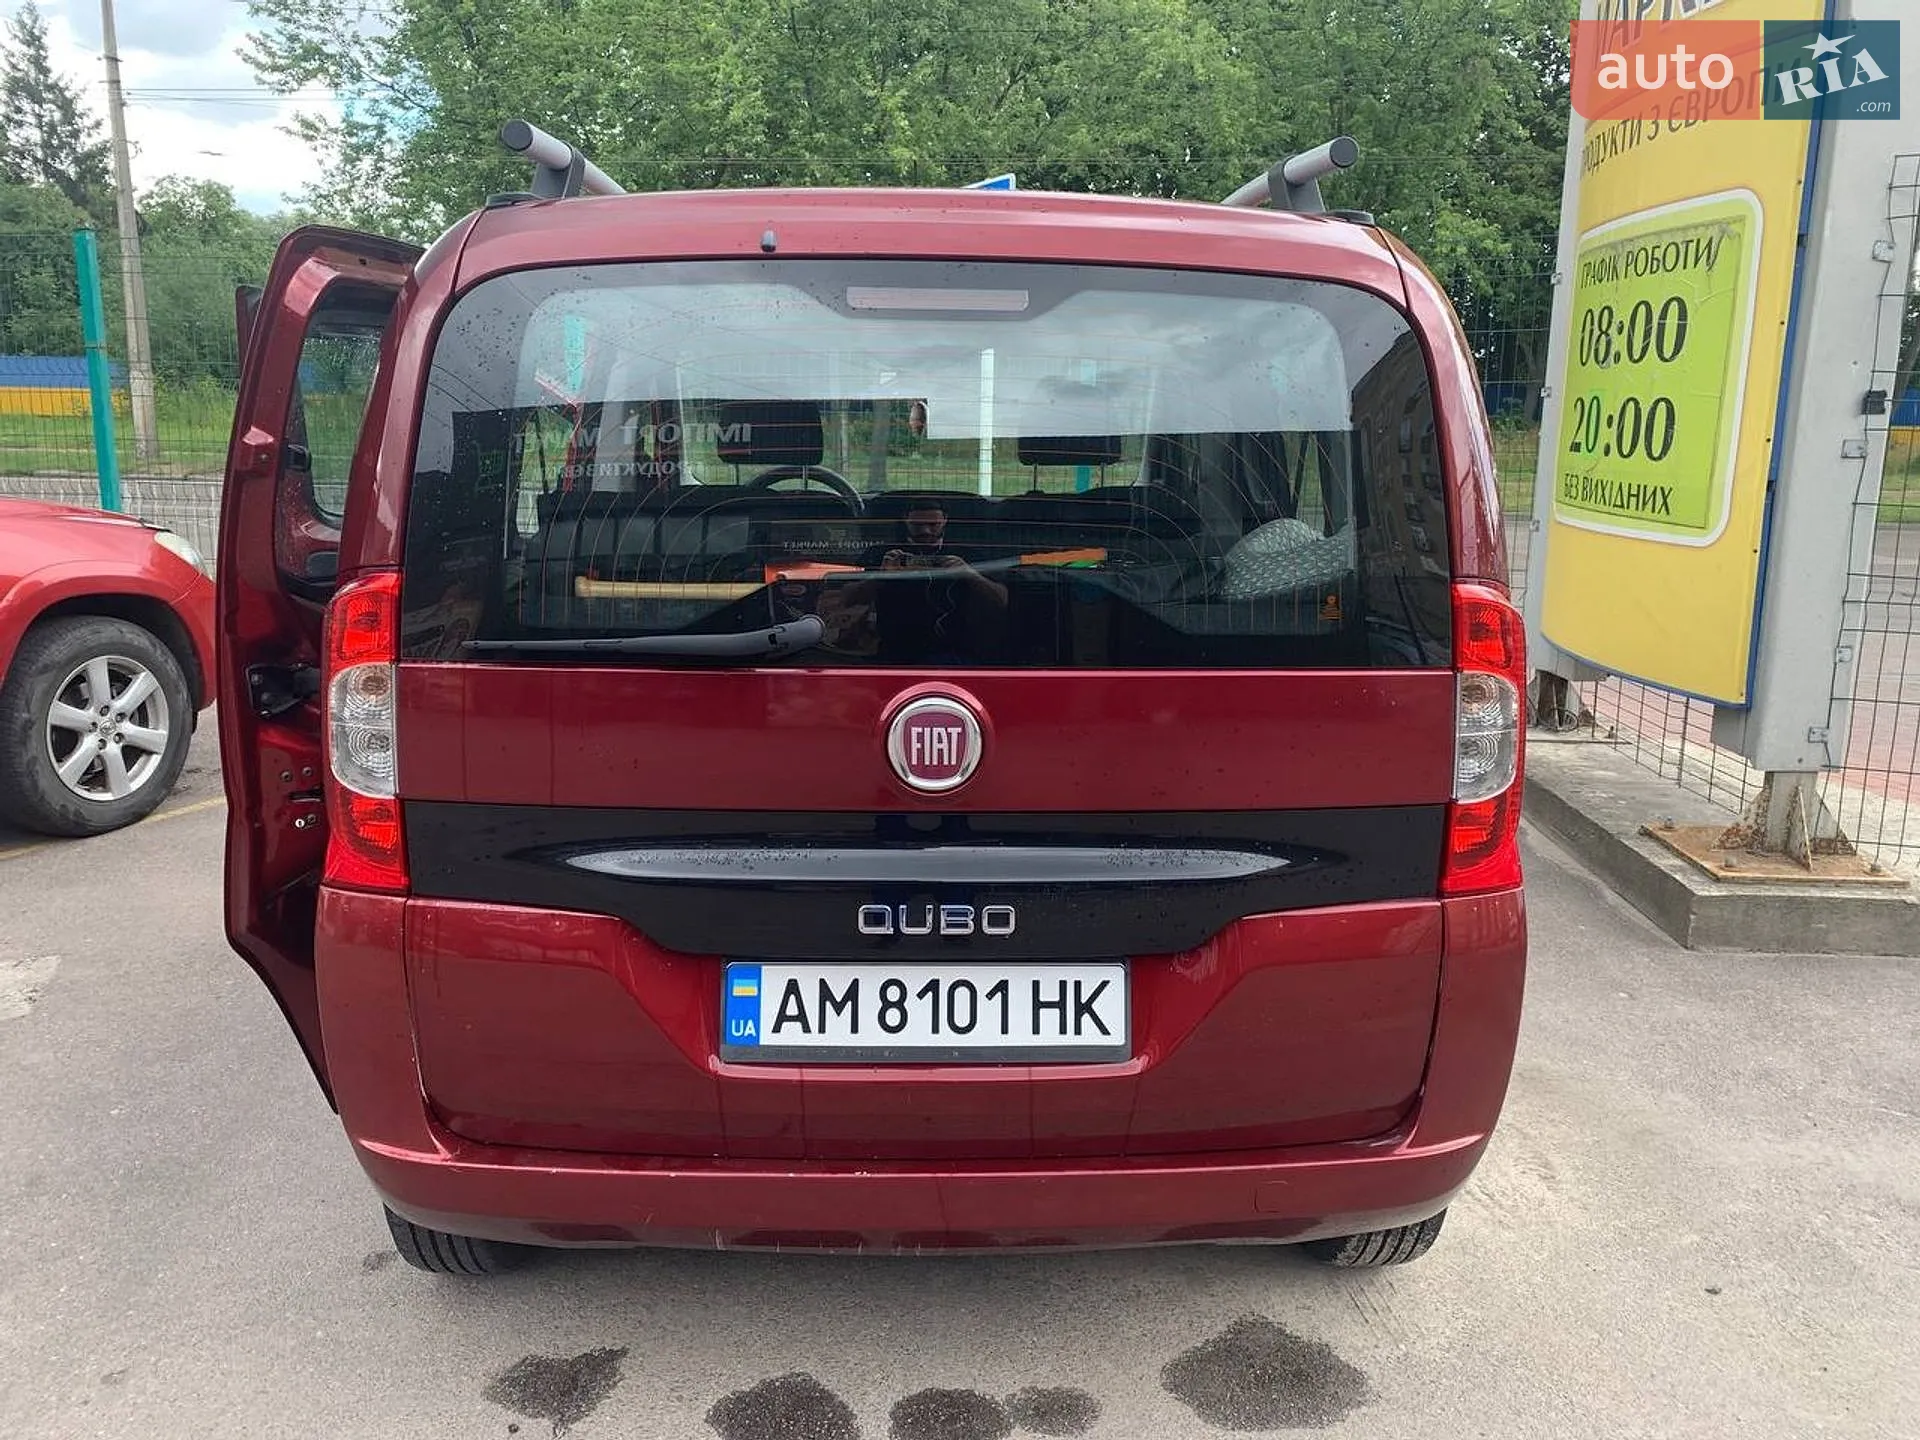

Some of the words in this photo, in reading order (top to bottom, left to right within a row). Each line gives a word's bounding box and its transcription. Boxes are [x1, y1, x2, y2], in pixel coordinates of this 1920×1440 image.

[1647, 104, 1661, 141] З
[1581, 255, 1619, 289] ГРАФІК
[1624, 236, 1714, 279] РОБОТИ
[1579, 296, 1688, 369] 08:00
[1569, 396, 1675, 462] 20:00
[1563, 473, 1580, 500] БЕЗ
[1581, 474, 1674, 516] ВИХІДНИХ
[910, 726, 962, 766] FIAT
[857, 903, 1016, 936] QUBO
[771, 977, 860, 1035] AM
[876, 977, 1010, 1035] 8101
[1031, 979, 1111, 1036] HK
[732, 1020, 757, 1037] UA
